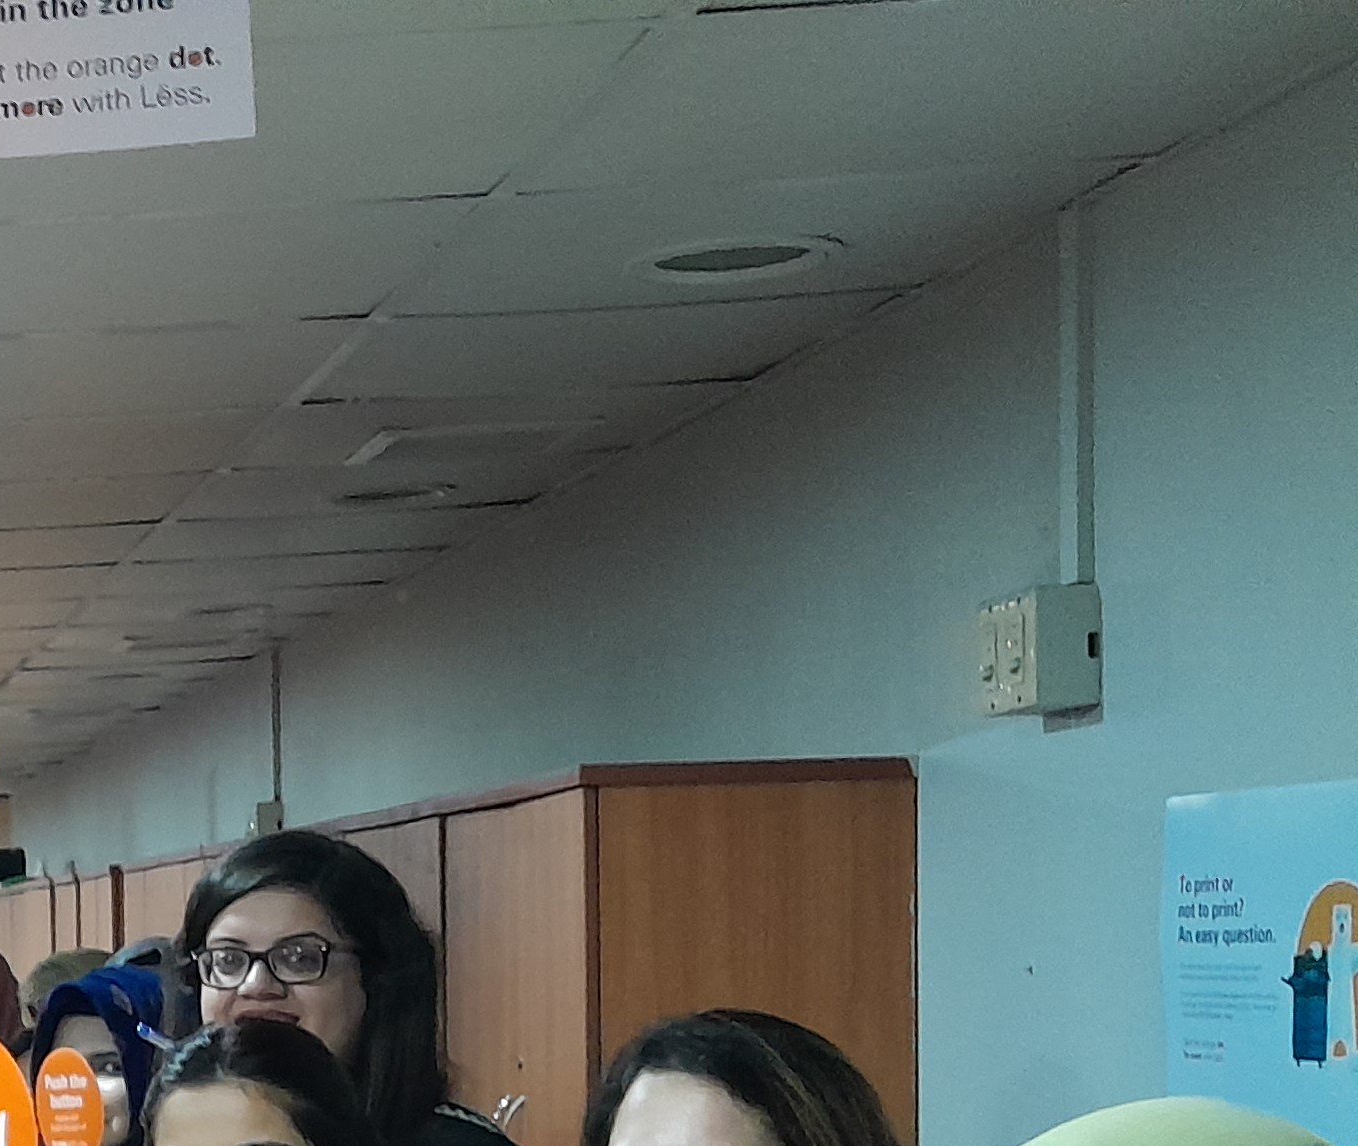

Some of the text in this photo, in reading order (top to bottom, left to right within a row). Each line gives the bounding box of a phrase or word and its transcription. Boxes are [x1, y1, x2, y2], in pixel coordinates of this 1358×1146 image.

[0, 0, 27, 22] in
[38, 0, 86, 20] the
[15, 58, 59, 81] the
[66, 53, 160, 80] orange
[169, 46, 222, 69] dot.
[72, 89, 131, 114] with
[1180, 874, 1233, 898] To print or
[1178, 898, 1244, 920] not to print?
[1178, 924, 1276, 947] An easy question.
